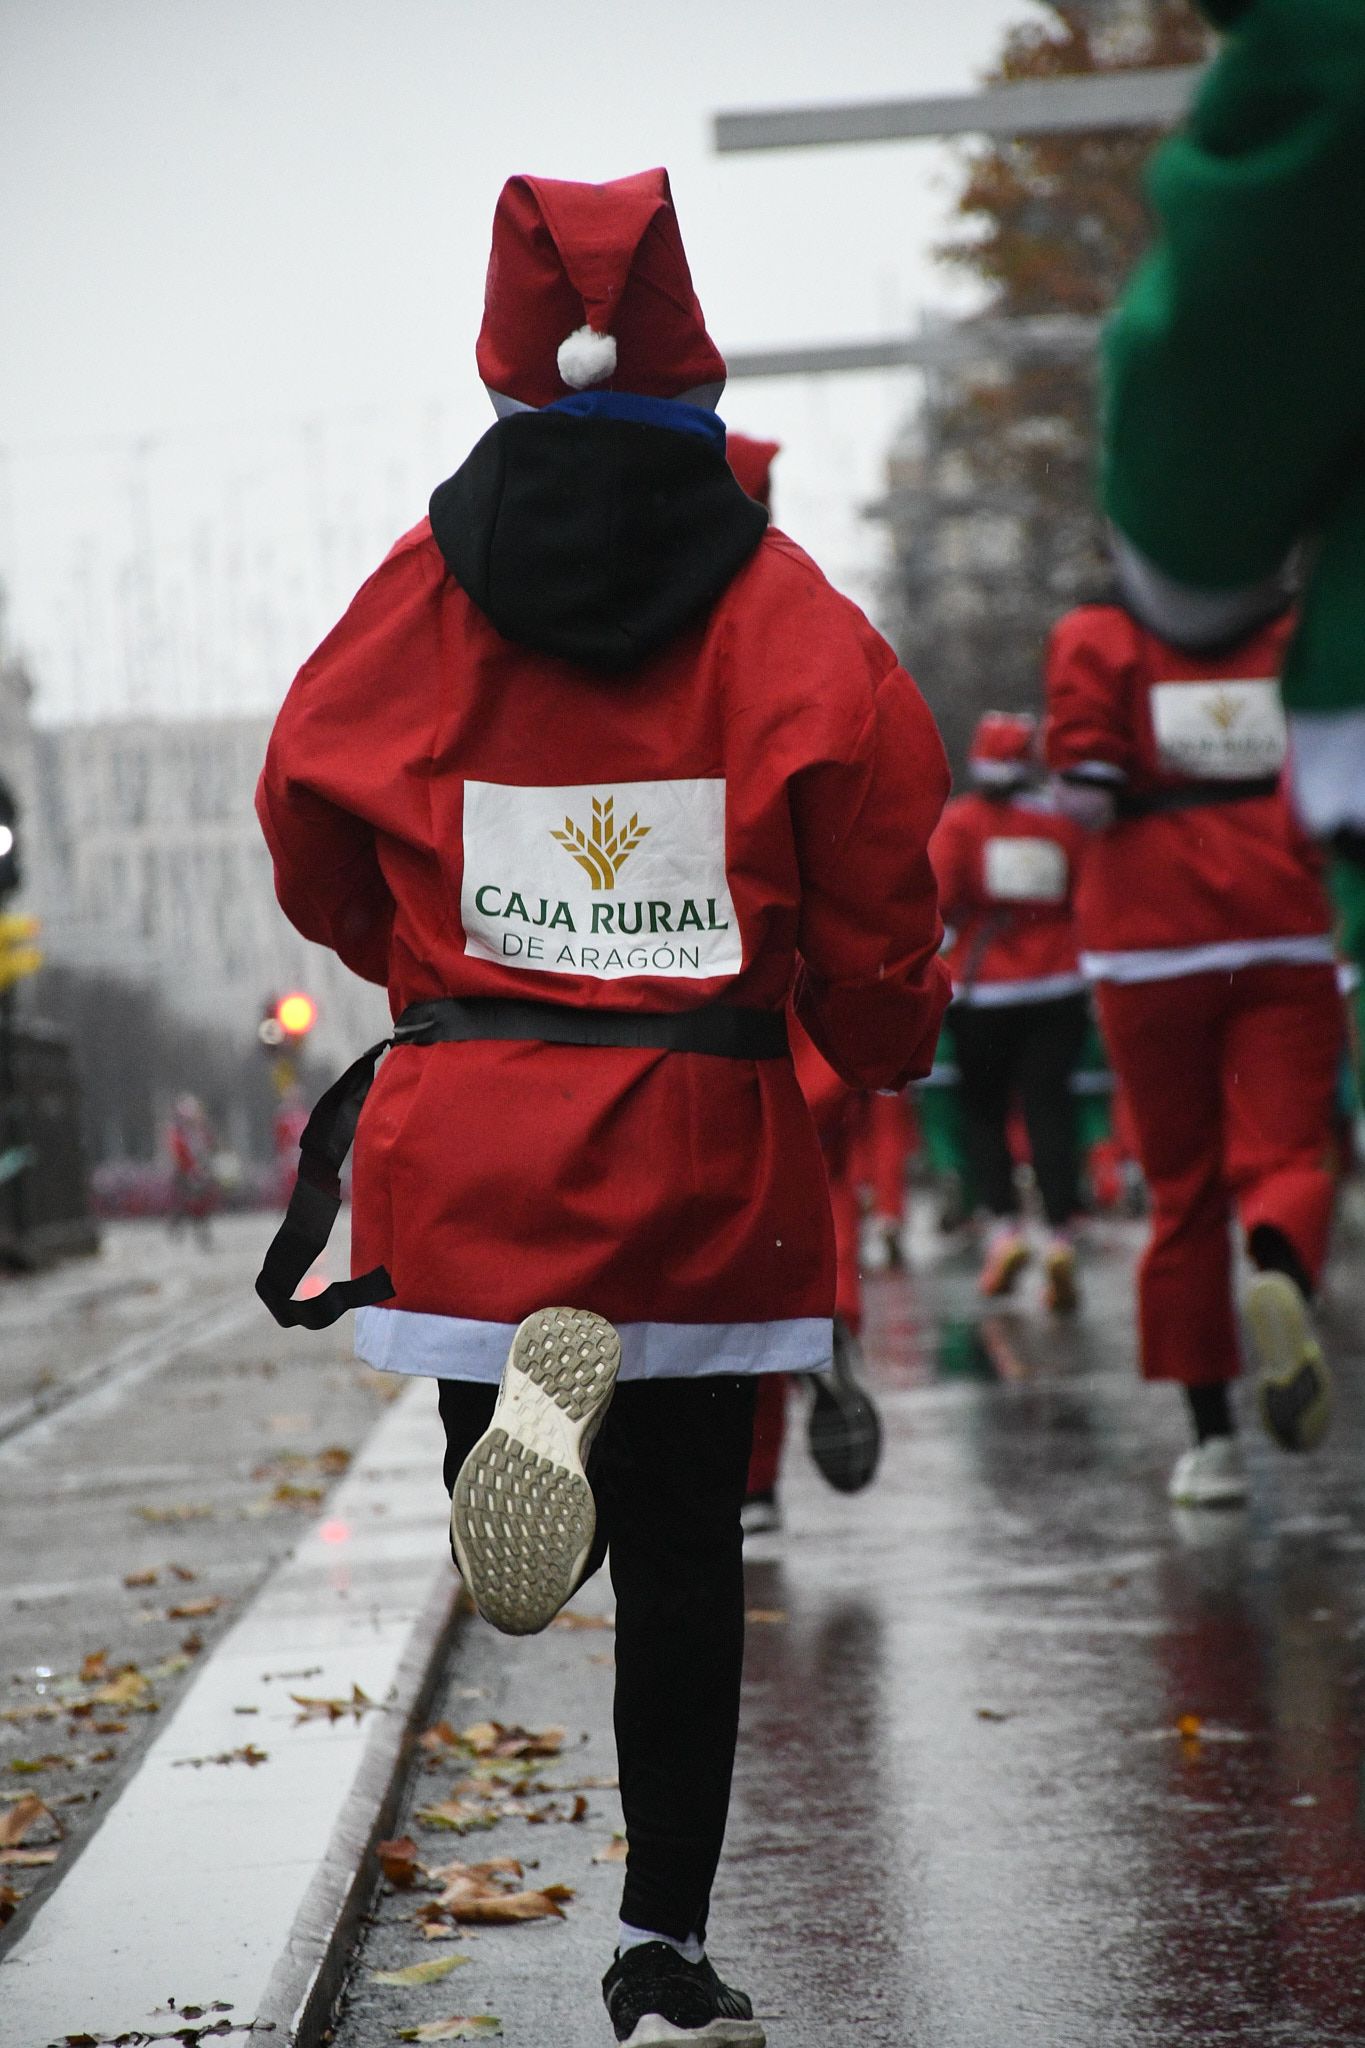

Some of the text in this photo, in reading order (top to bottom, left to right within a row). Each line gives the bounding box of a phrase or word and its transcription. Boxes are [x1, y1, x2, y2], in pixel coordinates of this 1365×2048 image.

[475, 885, 729, 935] CAJA RURAL
[502, 932, 700, 970] DE ARAGÓN
